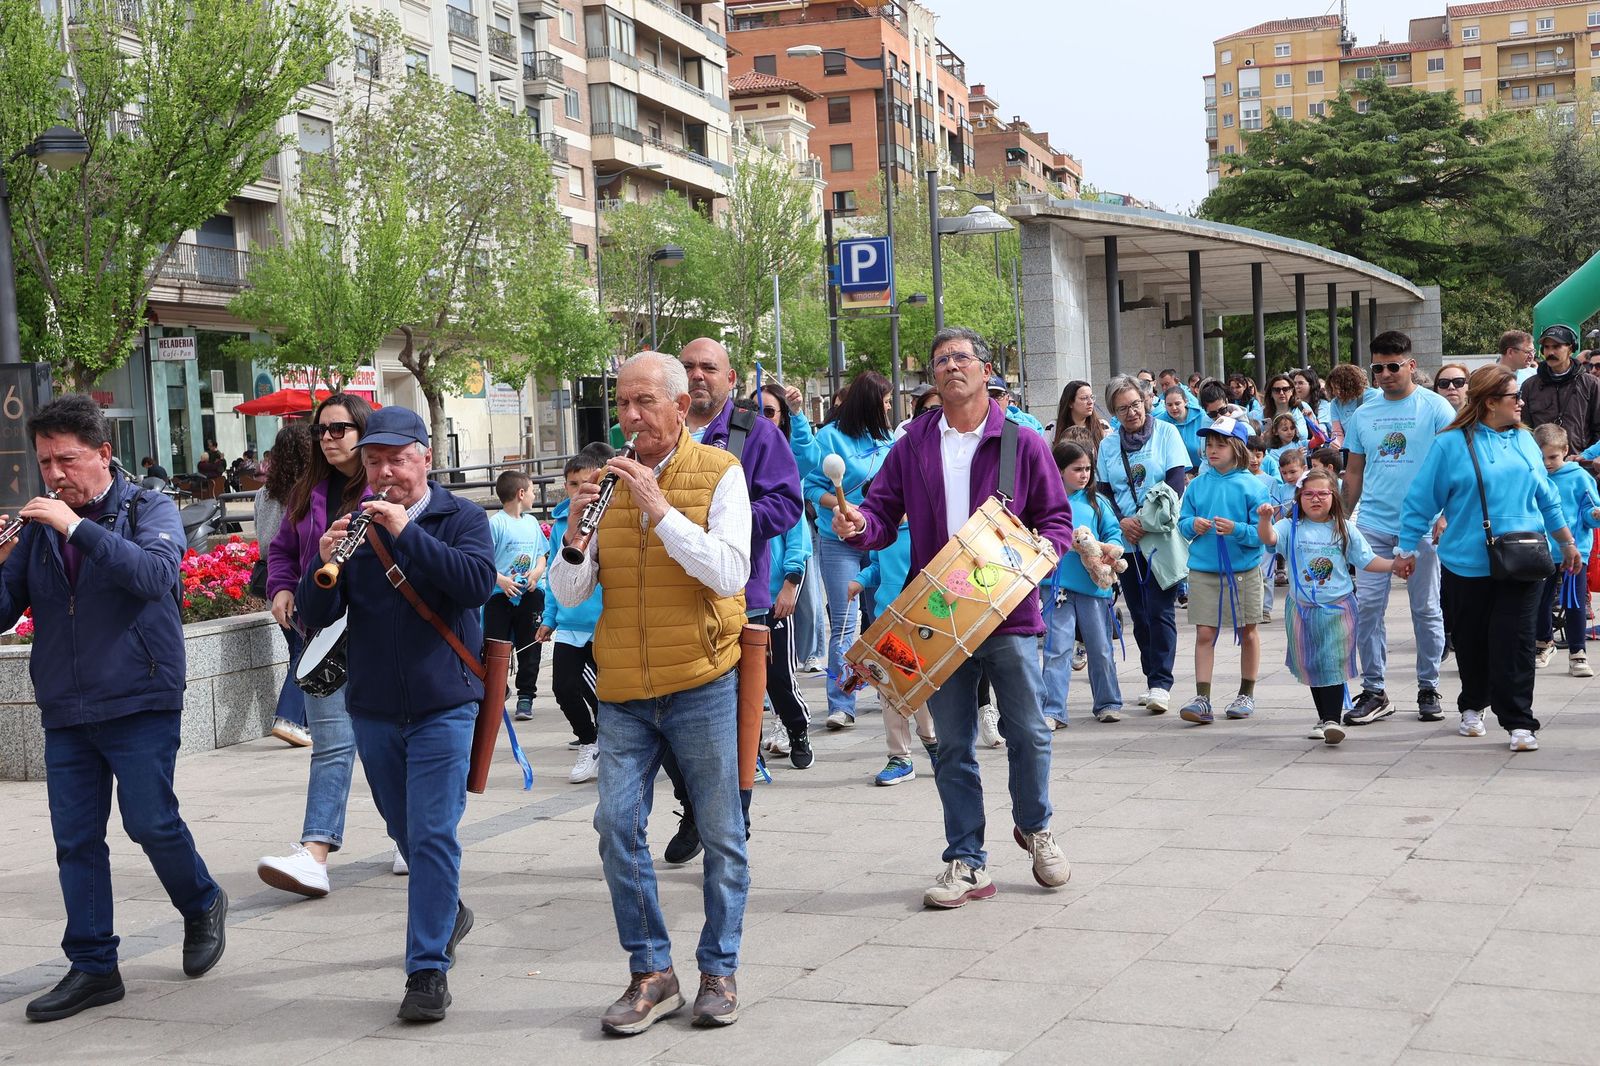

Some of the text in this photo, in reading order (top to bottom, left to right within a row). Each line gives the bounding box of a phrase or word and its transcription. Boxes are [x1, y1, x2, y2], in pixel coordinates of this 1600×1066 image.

[850, 243, 878, 283] P
[159, 338, 194, 349] HELADERIA
[3, 384, 24, 420] 6
